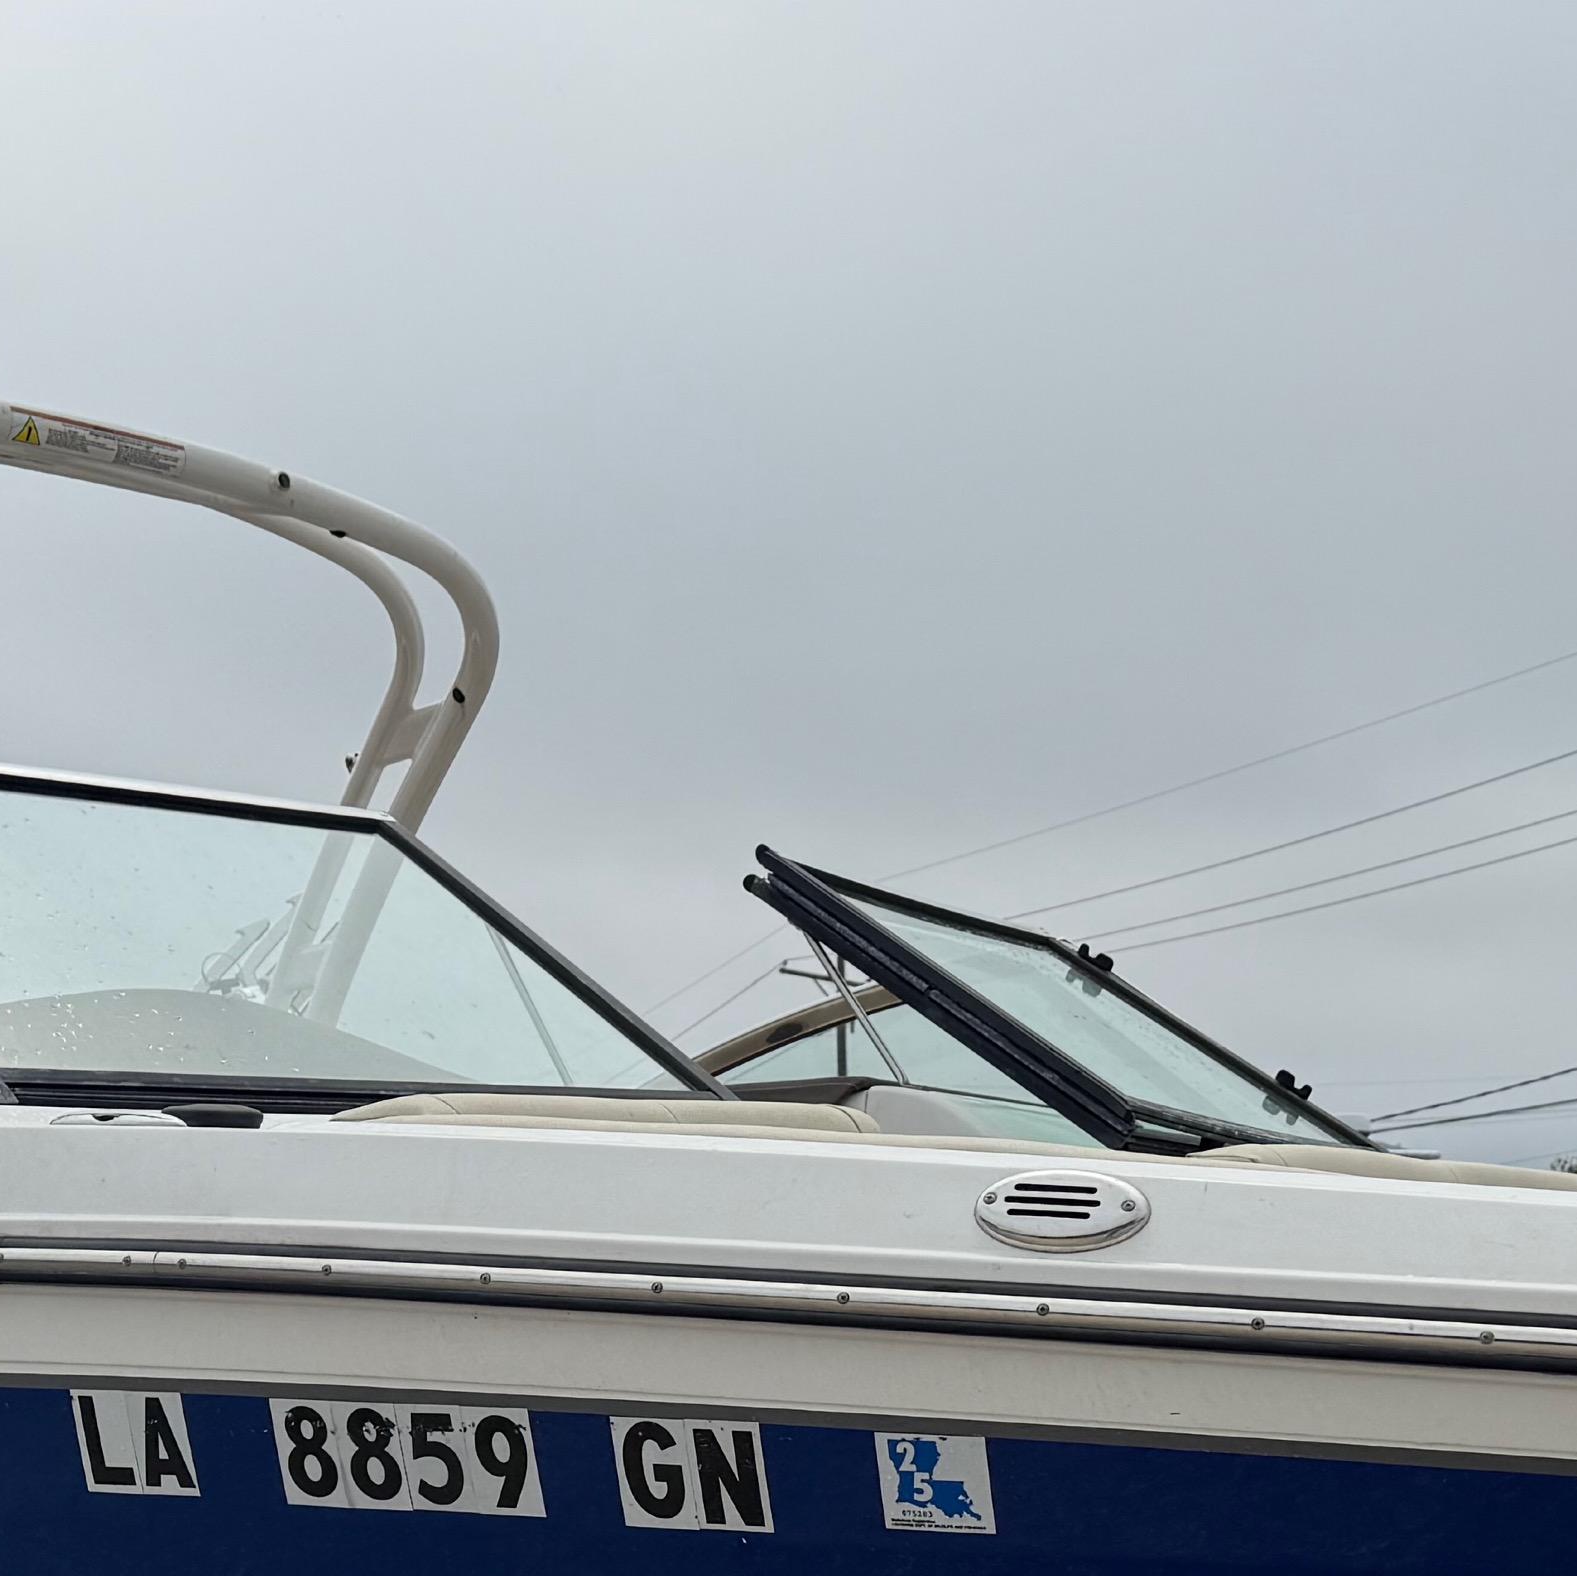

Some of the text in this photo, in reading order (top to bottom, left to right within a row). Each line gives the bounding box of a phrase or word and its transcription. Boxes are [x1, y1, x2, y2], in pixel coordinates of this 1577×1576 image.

[73, 1394, 768, 1526] LA 8859 GN
